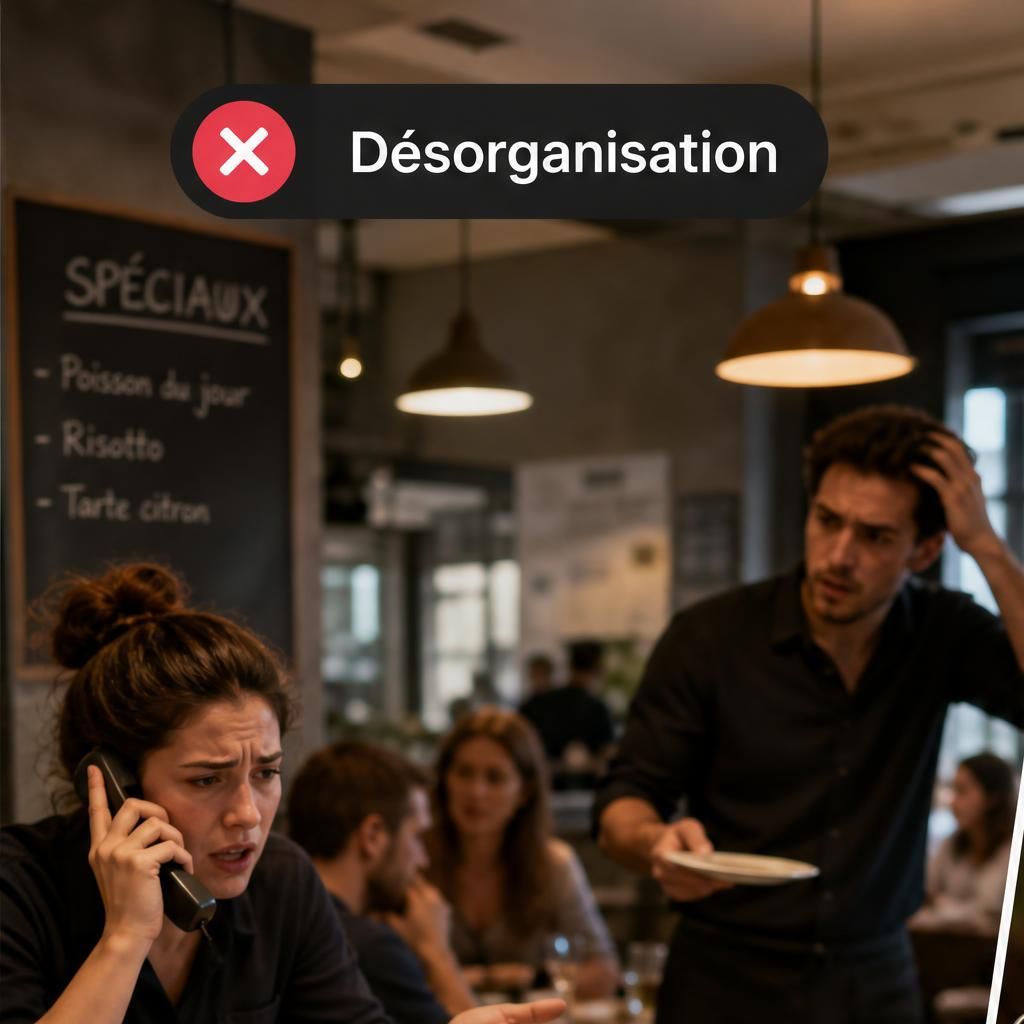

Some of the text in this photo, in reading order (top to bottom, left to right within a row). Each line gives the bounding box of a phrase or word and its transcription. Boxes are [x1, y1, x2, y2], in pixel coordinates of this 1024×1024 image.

[63, 251, 269, 329] SPÉCIAUX
[61, 353, 152, 397] Poisson
[160, 368, 191, 402] du
[193, 372, 250, 419] jour
[62, 419, 165, 461] Risotto
[60, 484, 131, 521] Tarte
[139, 492, 210, 524] citron
